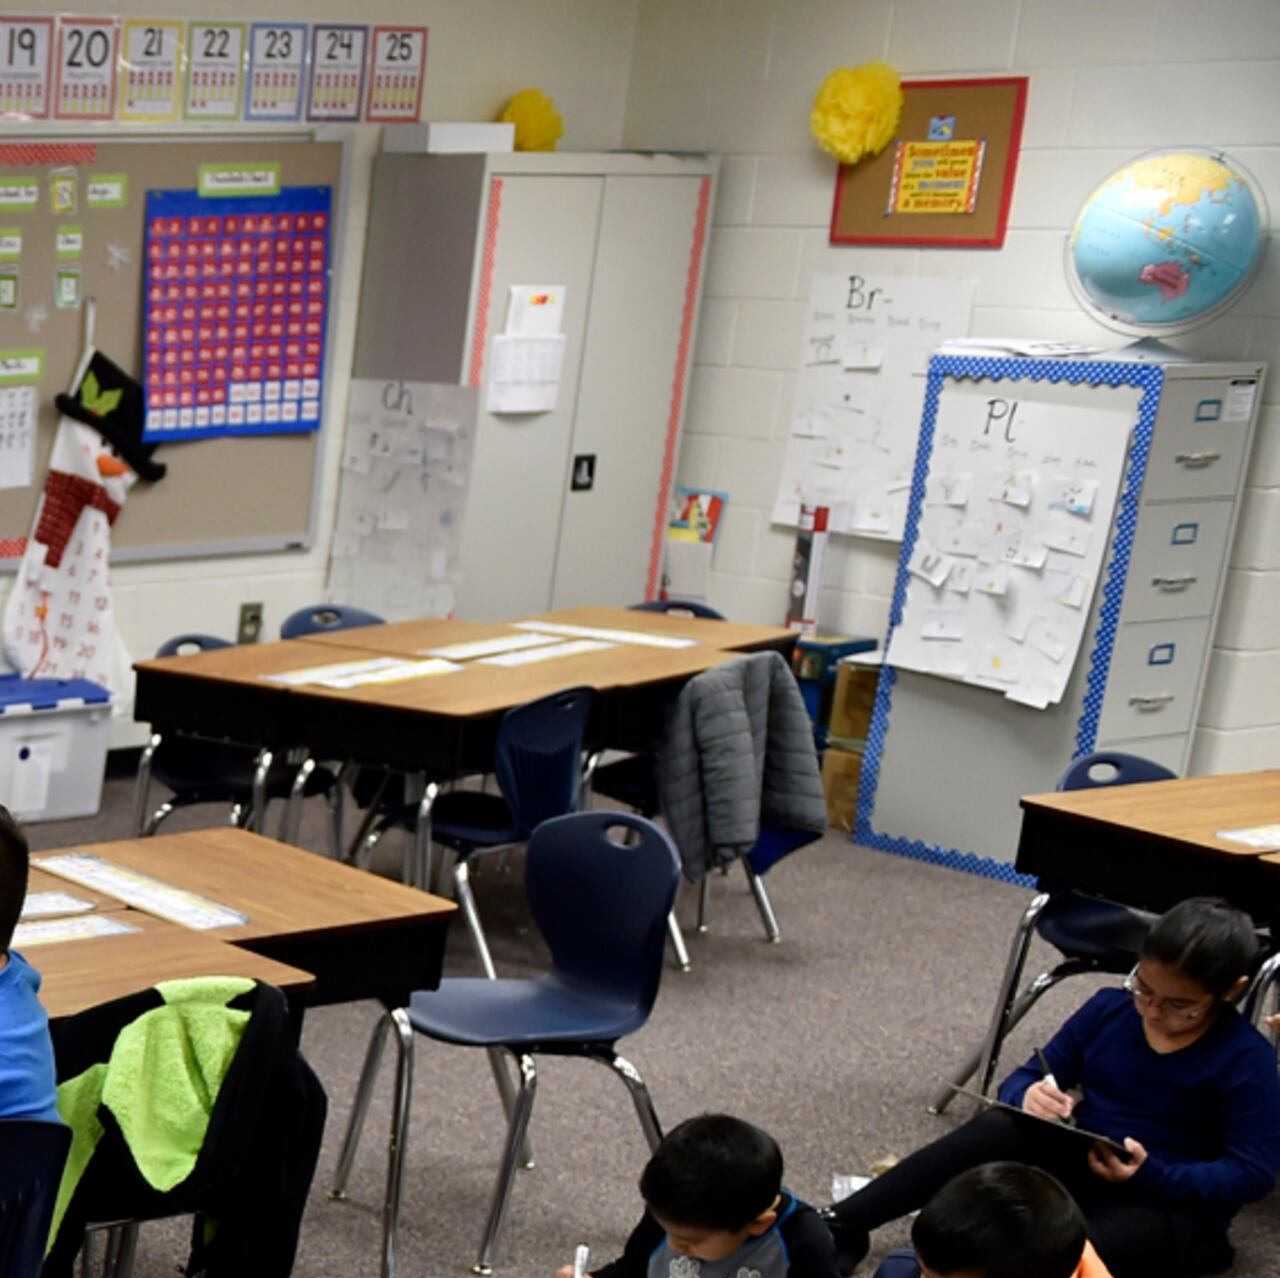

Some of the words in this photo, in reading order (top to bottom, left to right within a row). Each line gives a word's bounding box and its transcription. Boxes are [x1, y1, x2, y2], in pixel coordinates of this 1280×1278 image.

[8, 28, 36, 66] 19
[66, 30, 110, 67] 20
[142, 29, 163, 57] 21
[202, 30, 231, 58] 22
[264, 30, 293, 58] 23
[325, 31, 353, 60] 24
[386, 33, 414, 61] 25
[382, 380, 414, 416] Ch
